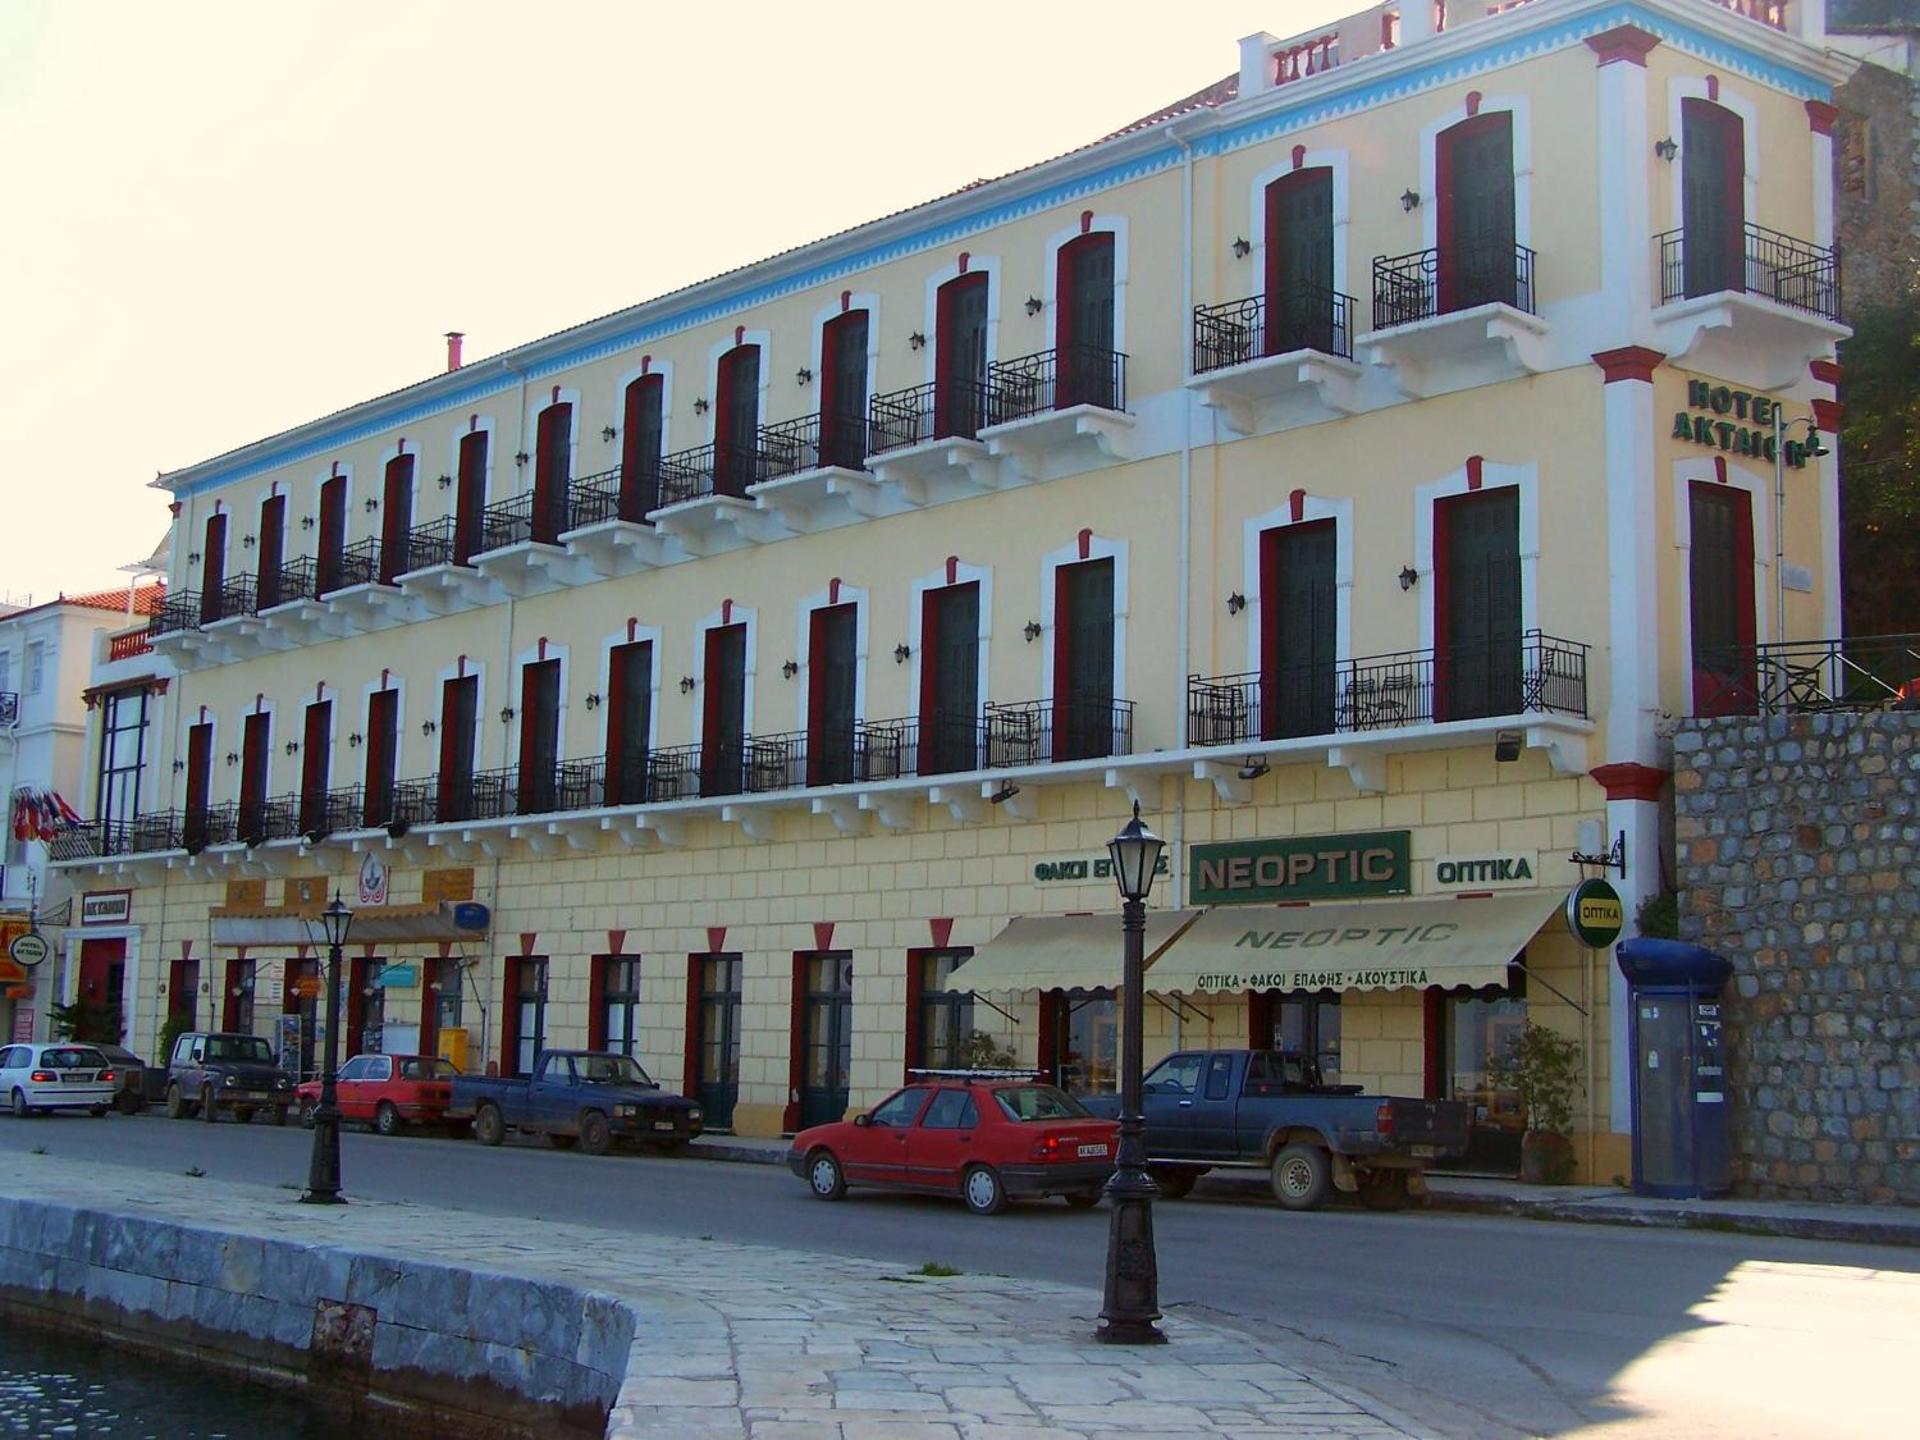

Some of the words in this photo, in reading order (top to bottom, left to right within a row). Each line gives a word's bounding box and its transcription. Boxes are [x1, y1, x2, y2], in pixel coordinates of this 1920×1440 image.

[1688, 379, 1788, 430] HOTEL
[1035, 860, 1088, 880] ΦΑΚΟΙ
[1200, 848, 1394, 890] NEOPTIC
[1437, 857, 1532, 884] ΟΠΤΙΚΑ
[1583, 906, 1619, 920] ΟΠΤΙΚΑ
[1235, 923, 1458, 949] NEOPTIC
[1198, 975, 1239, 988] ΟΠΤΙΚΑ
[1250, 973, 1285, 988] ΦΑΚΟΙ
[1294, 972, 1343, 986] ΕΠΑΦΗΣ
[1355, 970, 1428, 985] ΑΚΟΥΣΤΙΚΑ
